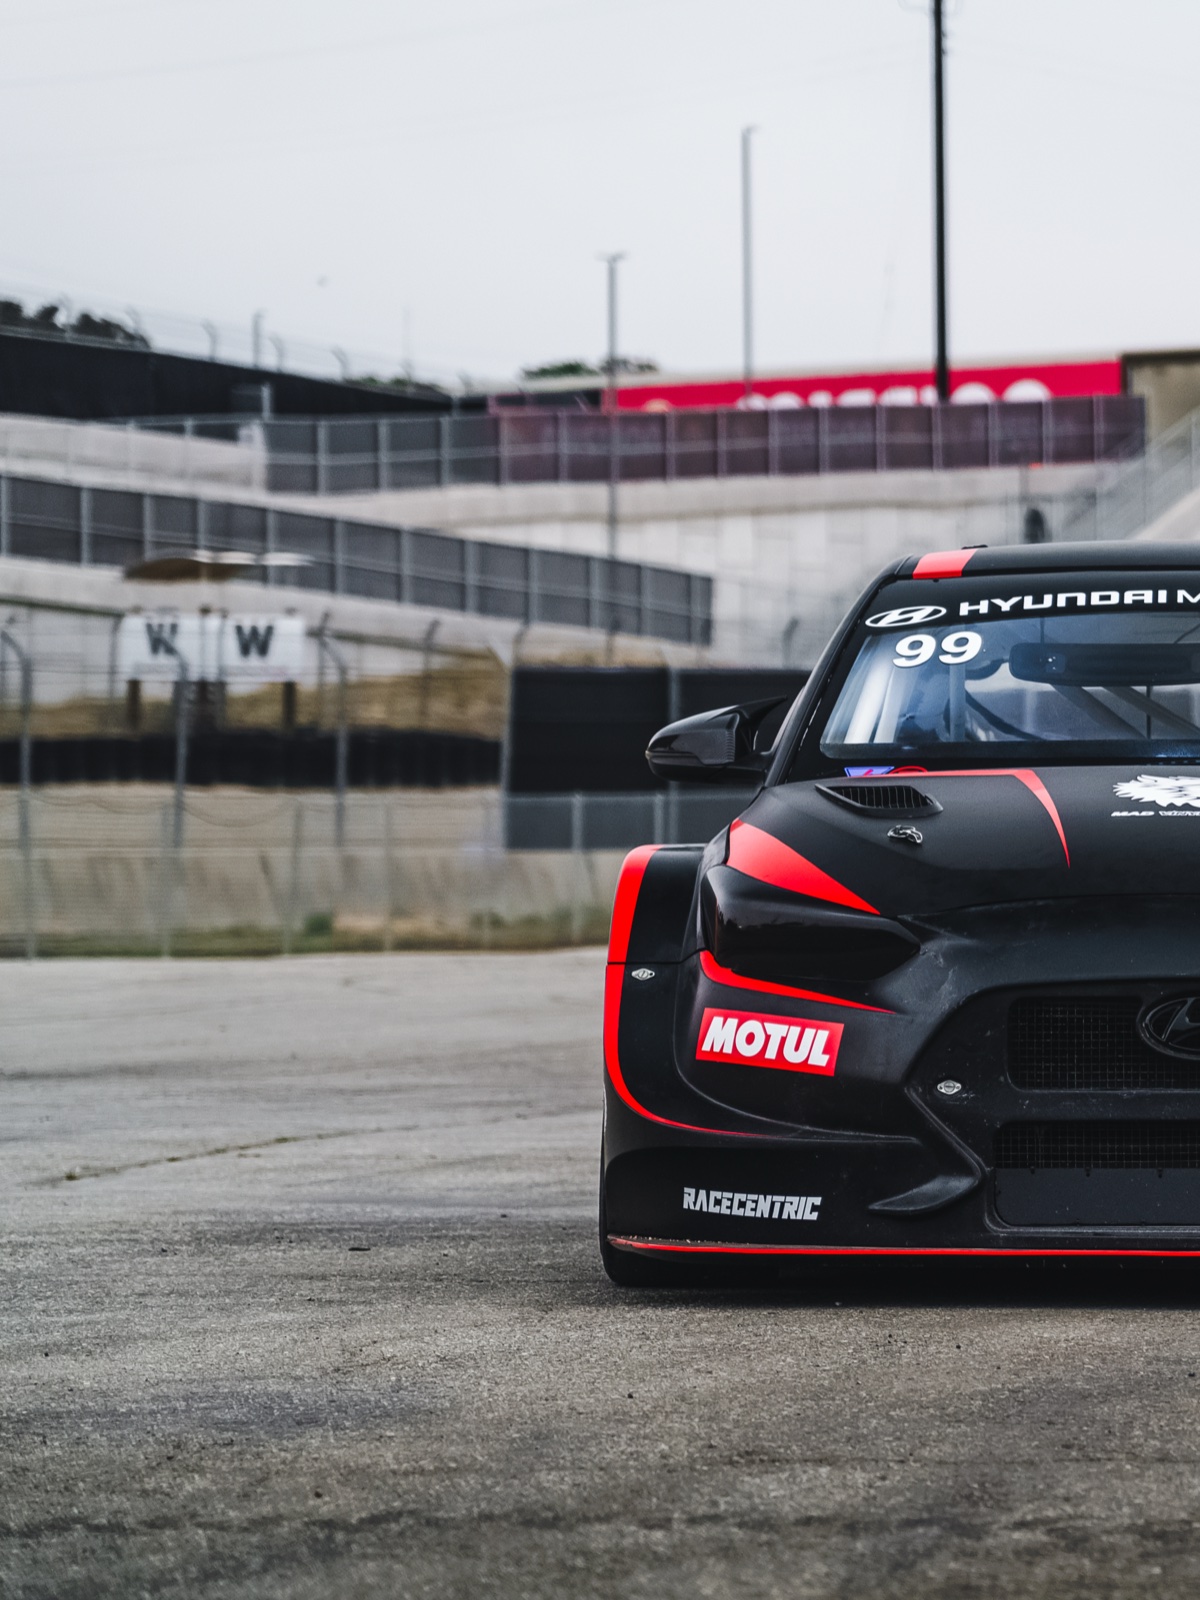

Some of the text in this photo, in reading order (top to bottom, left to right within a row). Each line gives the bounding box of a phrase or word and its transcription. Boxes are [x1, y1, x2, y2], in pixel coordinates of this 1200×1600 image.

[959, 589, 1167, 616] HYUNDAI
[235, 625, 274, 657] W
[892, 631, 982, 668] 99
[701, 1016, 830, 1067] MOTUL
[683, 1187, 822, 1220] RACECENTRIC
